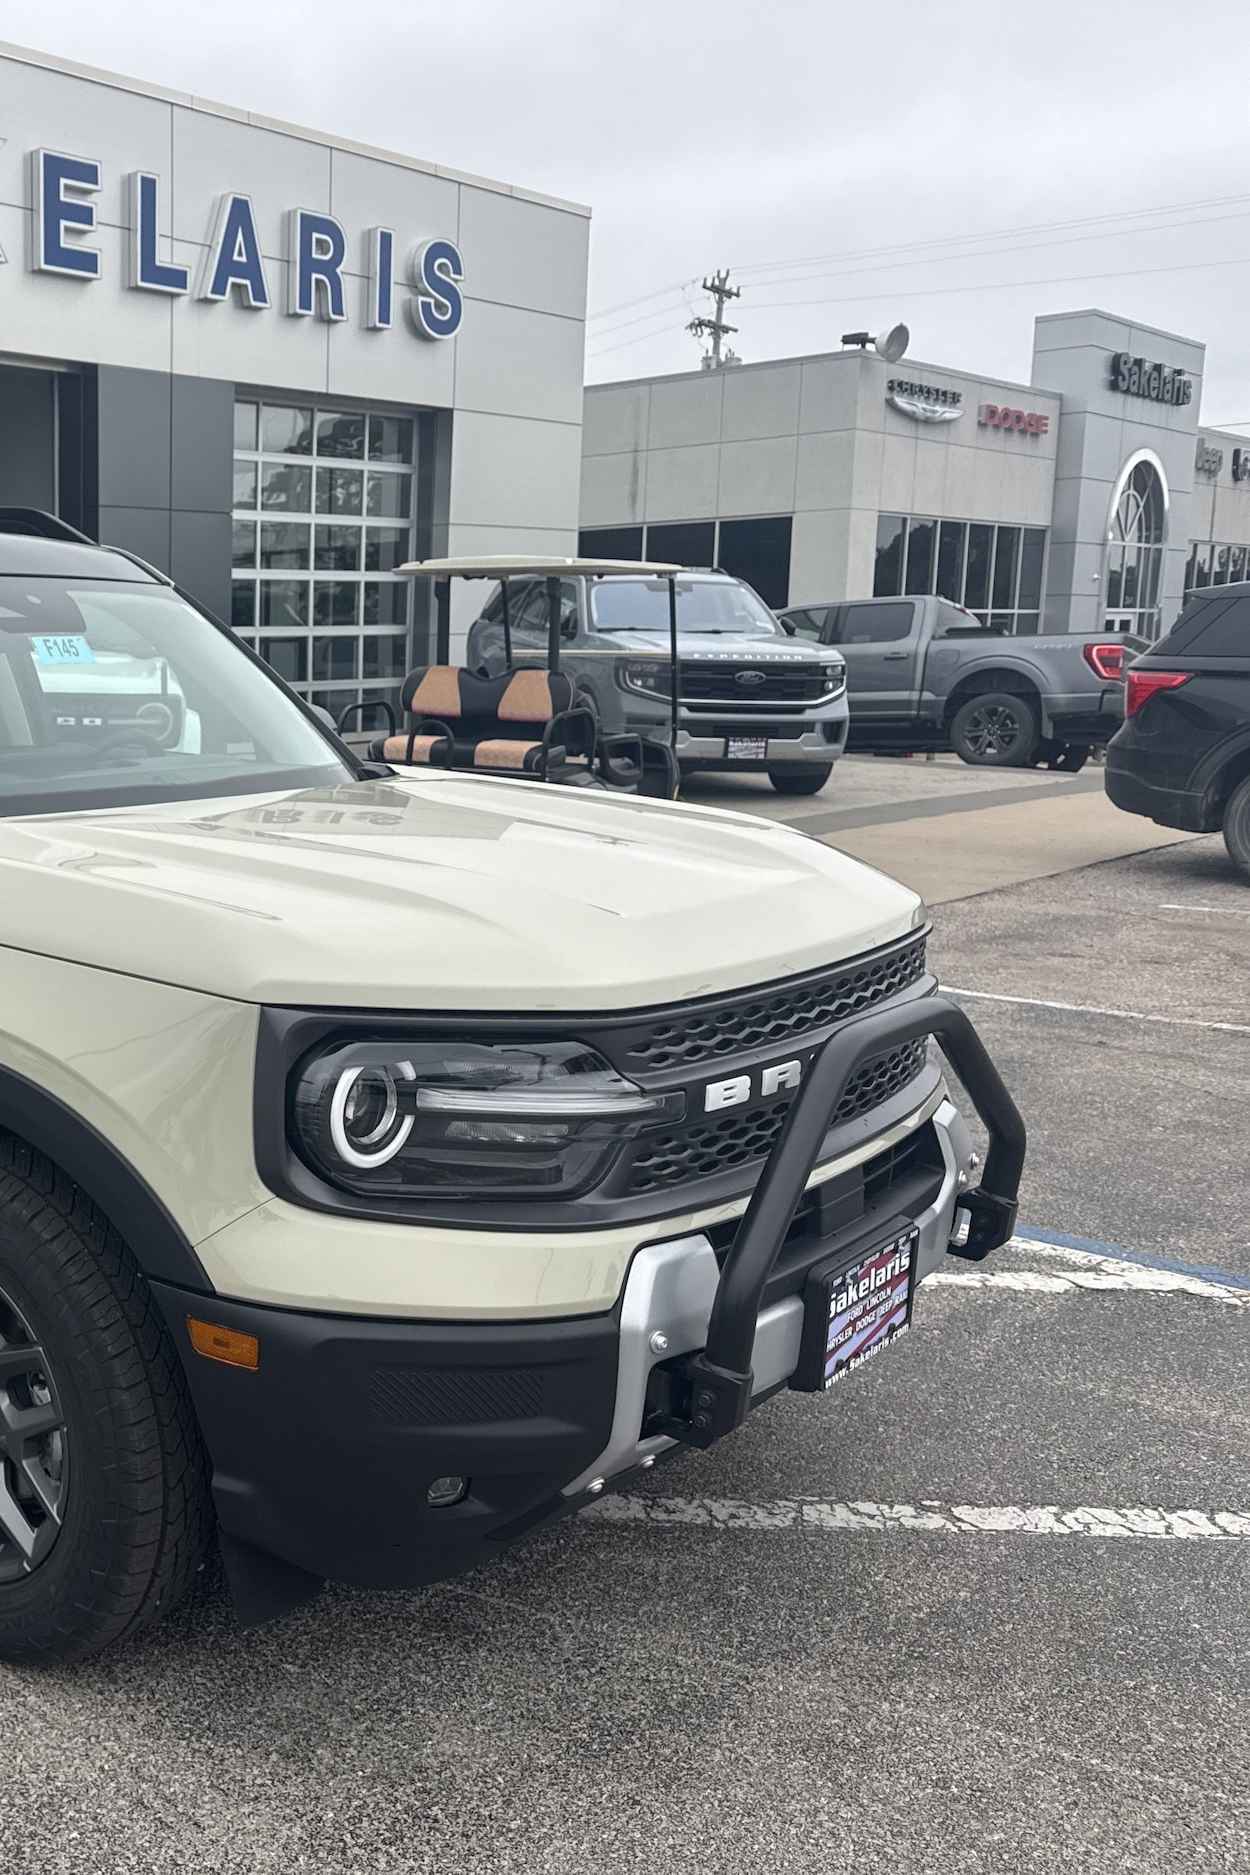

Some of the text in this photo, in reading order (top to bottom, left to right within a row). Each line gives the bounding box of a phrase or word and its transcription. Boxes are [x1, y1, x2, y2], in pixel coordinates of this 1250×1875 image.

[1112, 352, 1192, 405] Sakelaris
[981, 404, 1049, 435] DODGE
[1195, 437, 1223, 477] Jeep
[43, 639, 80, 657] F145
[826, 1289, 908, 1352] HRYSLER DODGE JEEP RAM
[847, 1286, 892, 1324] FORD LINCOLN
[825, 1323, 910, 1390] www.Sakelaris.com
